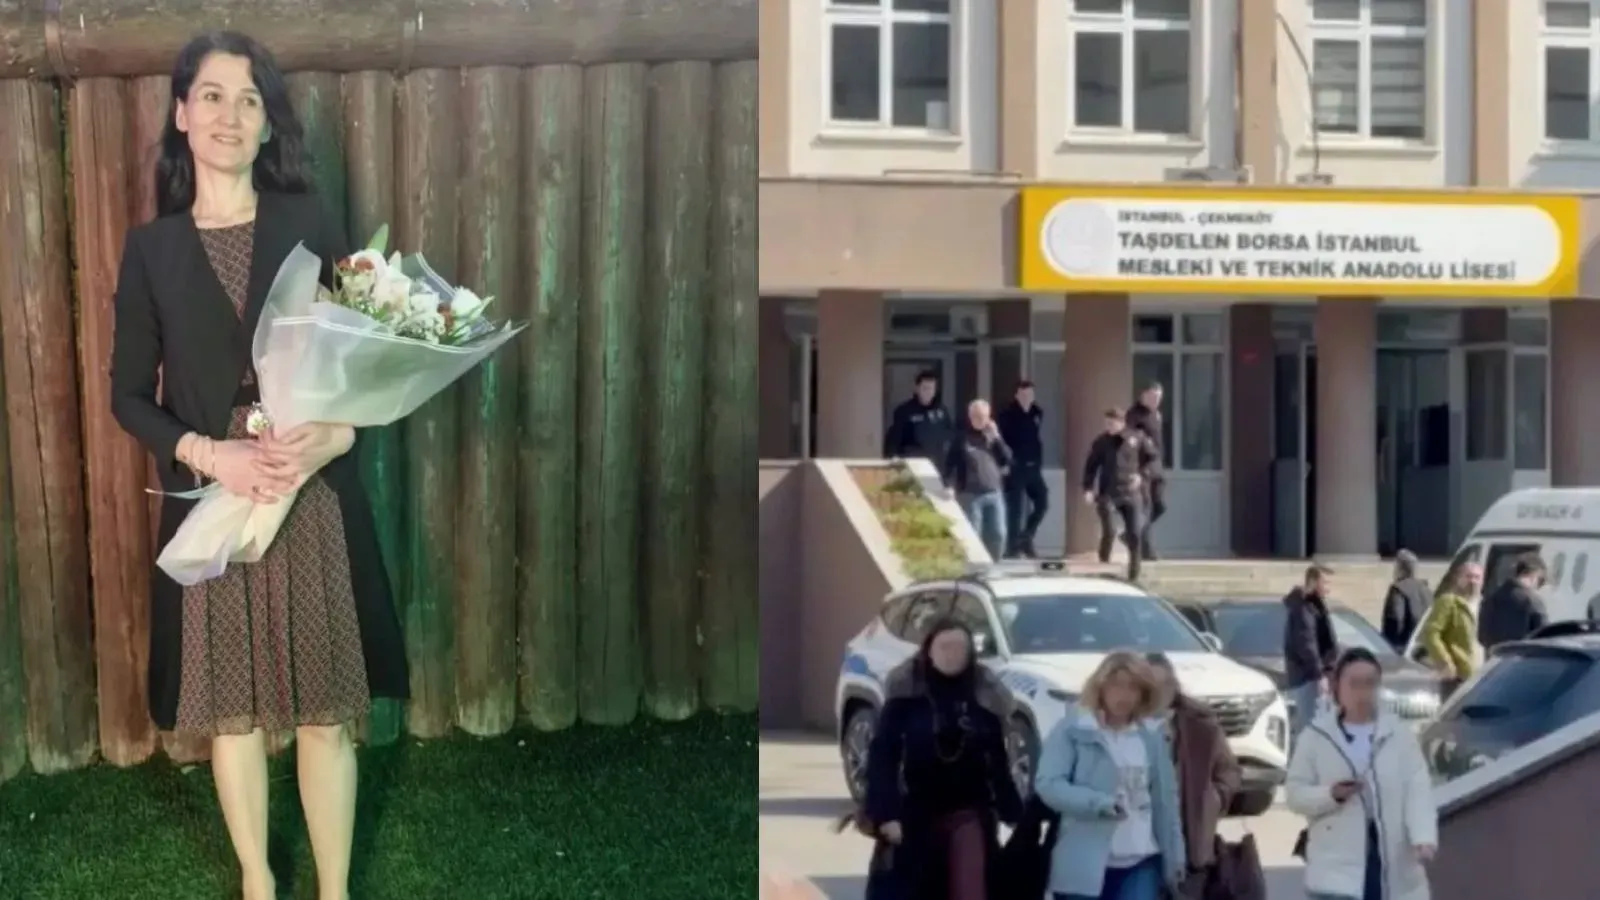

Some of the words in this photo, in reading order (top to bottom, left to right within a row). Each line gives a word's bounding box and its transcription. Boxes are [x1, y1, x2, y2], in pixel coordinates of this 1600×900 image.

[1118, 231, 1230, 252] TAŞDELEN
[1237, 233, 1310, 250] BORSA
[1317, 231, 1421, 253] İSTANBUL
[1118, 256, 1213, 275] MESLEKİ
[1220, 260, 1248, 276] VE
[1255, 258, 1336, 277] TEKNİK
[1343, 261, 1444, 279] ANADOLU
[1451, 258, 1516, 280] LİSESİ
